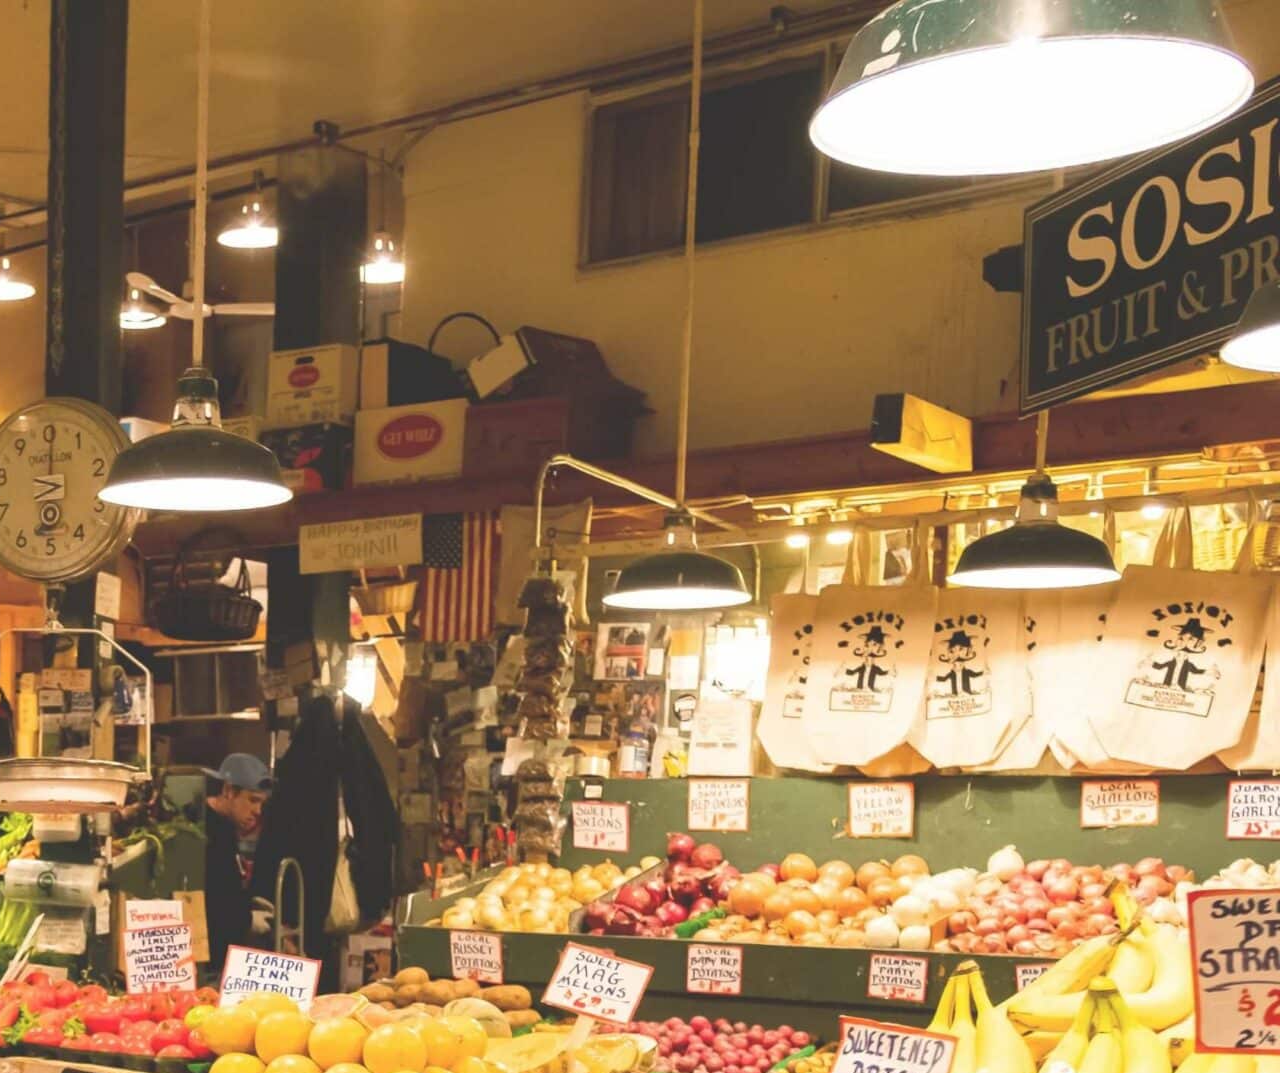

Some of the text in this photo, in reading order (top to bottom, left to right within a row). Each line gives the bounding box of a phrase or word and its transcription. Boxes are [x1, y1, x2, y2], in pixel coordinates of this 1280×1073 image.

[1065, 117, 1280, 297] SOSI
[1045, 280, 1166, 374] FRUIT
[1176, 271, 1210, 320] &
[29, 452, 72, 467] CHATILLON
[1100, 783, 1142, 793] LOCAL
[574, 816, 623, 831] ONIONS
[1211, 898, 1280, 919] SWE
[453, 942, 492, 955] RUSSET
[245, 952, 304, 972] FLORIDA
[576, 951, 622, 971] SWEET
[1199, 946, 1280, 978] STRA
[130, 968, 189, 983] TOMATOES
[247, 965, 289, 982] PINK
[569, 963, 623, 985] MAG
[872, 975, 922, 985] POTATOES
[556, 976, 627, 998] MELONS
